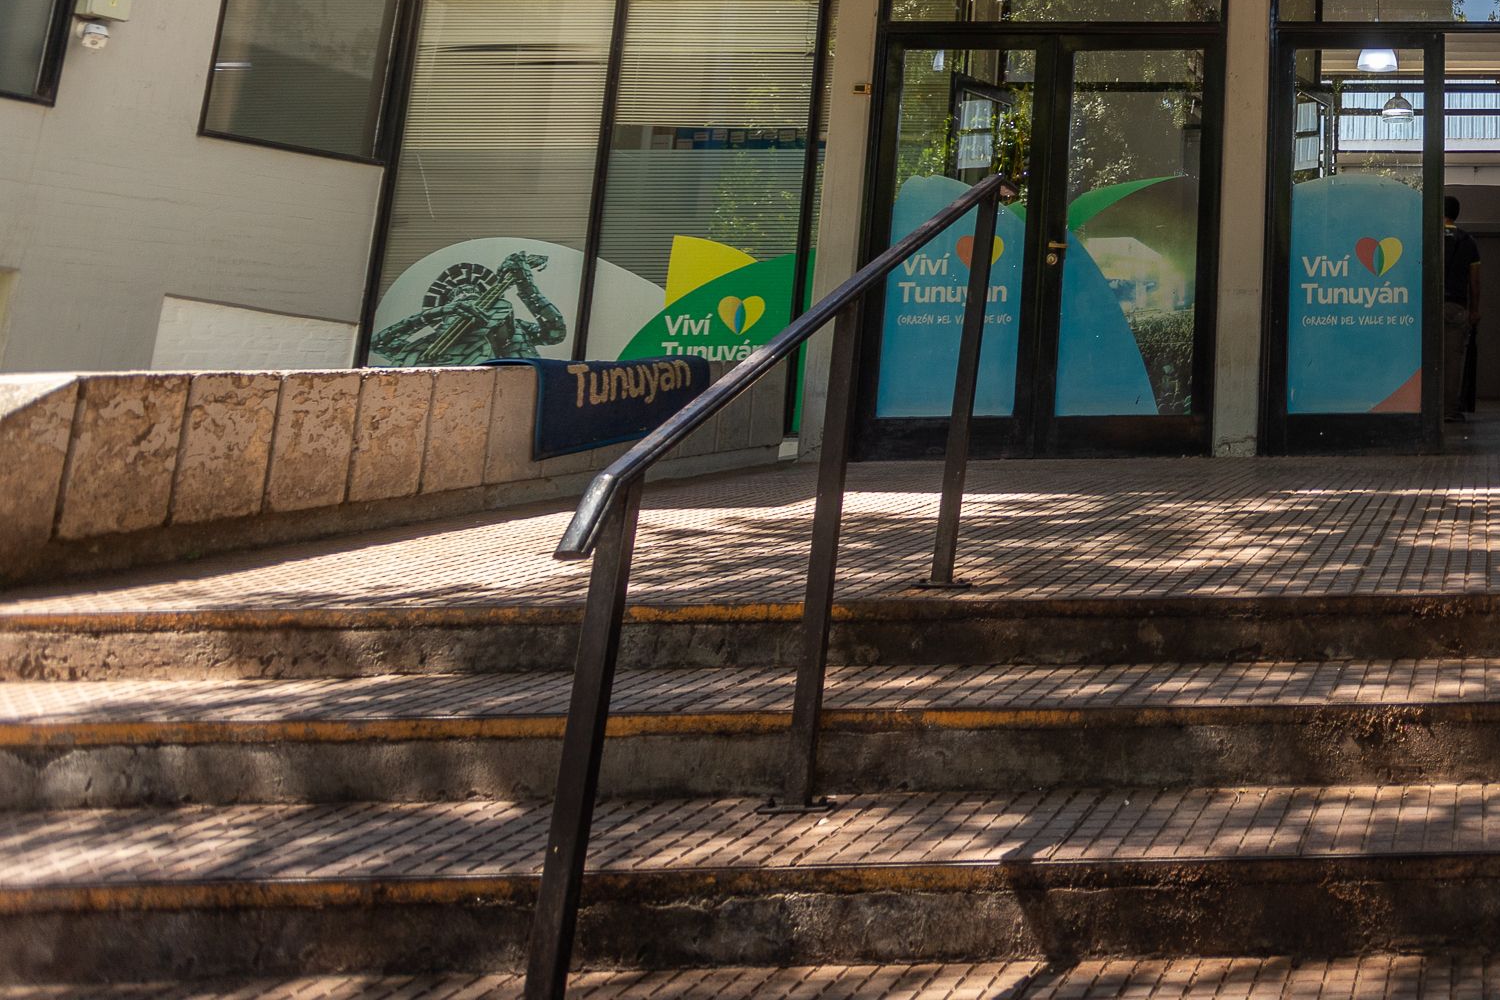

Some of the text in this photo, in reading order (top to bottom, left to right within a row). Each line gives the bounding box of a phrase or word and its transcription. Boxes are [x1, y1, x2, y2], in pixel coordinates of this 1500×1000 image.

[902, 252, 951, 276] Viví
[1301, 254, 1351, 278] Viví
[1301, 281, 1409, 309] Tunuyán
[664, 313, 713, 336] Viví
[1341, 315, 1356, 326] DEL
[1359, 315, 1384, 326] VALLE
[1387, 315, 1398, 326] DE
[566, 359, 692, 409] Tunuyan
